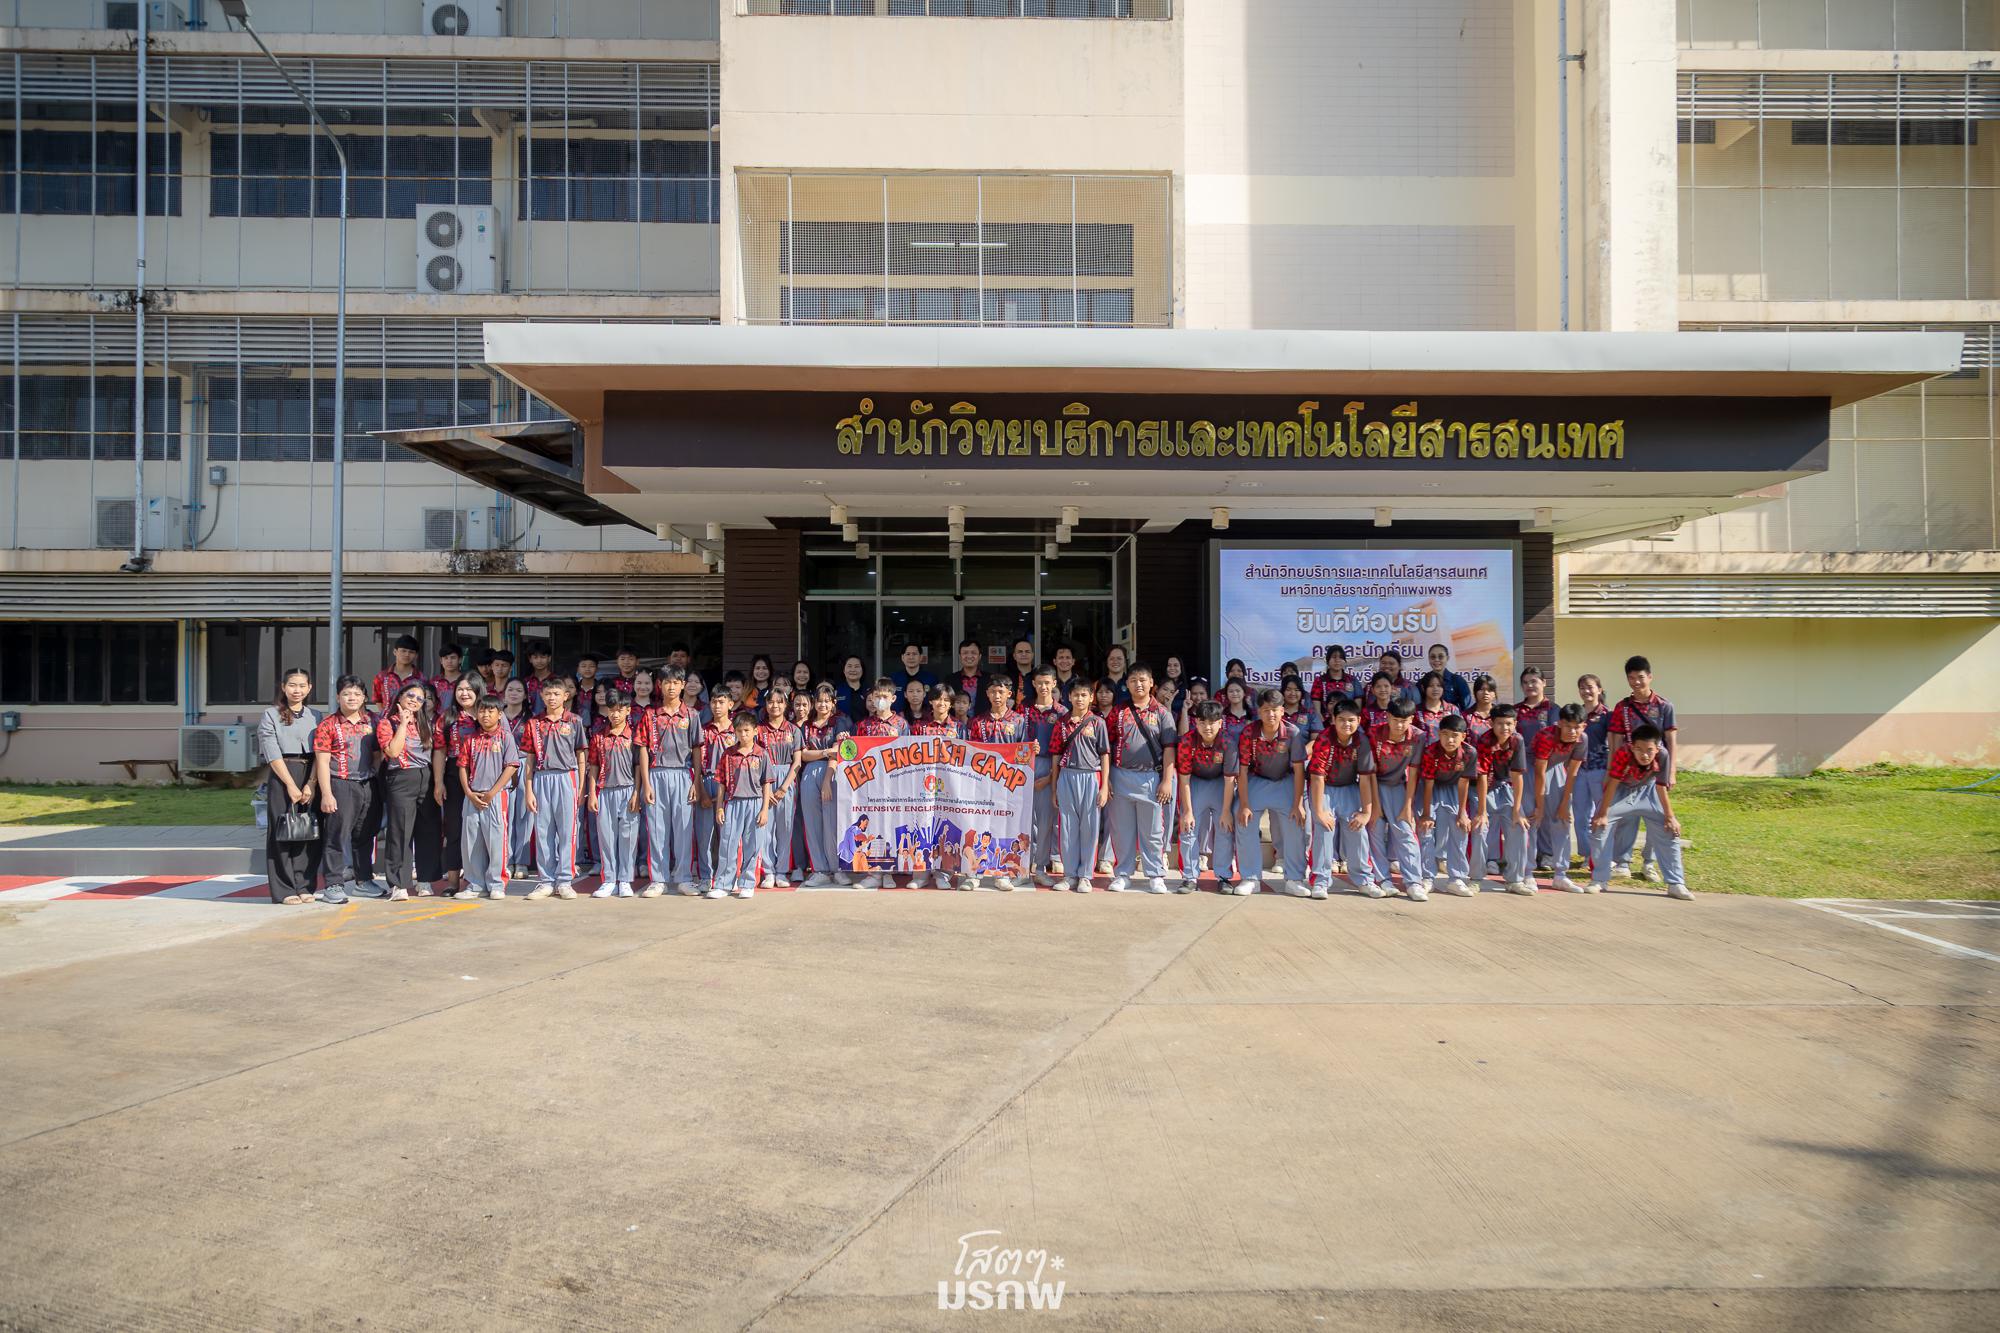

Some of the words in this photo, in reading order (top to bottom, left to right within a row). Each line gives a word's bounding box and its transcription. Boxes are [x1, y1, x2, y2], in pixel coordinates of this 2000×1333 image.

[834, 397, 1625, 460] สำนักวิทยบริการและเทคโนโลยีสารสนเทศ
[1244, 563, 1488, 580] สำนักวิทยบริการและเทคโนโลยีสารสนเทศ
[1280, 582, 1453, 600] มหาวิทยาลัยราชภัฏกำแพงเพชร
[1296, 606, 1437, 633] ยินดีต้อนรับ
[970, 752, 1027, 792] CAMP
[852, 804, 902, 813] INTENSIVE
[904, 804, 942, 812] ENGLISH
[943, 806, 991, 816] PROGRAM
[993, 807, 1014, 818] (IEP)
